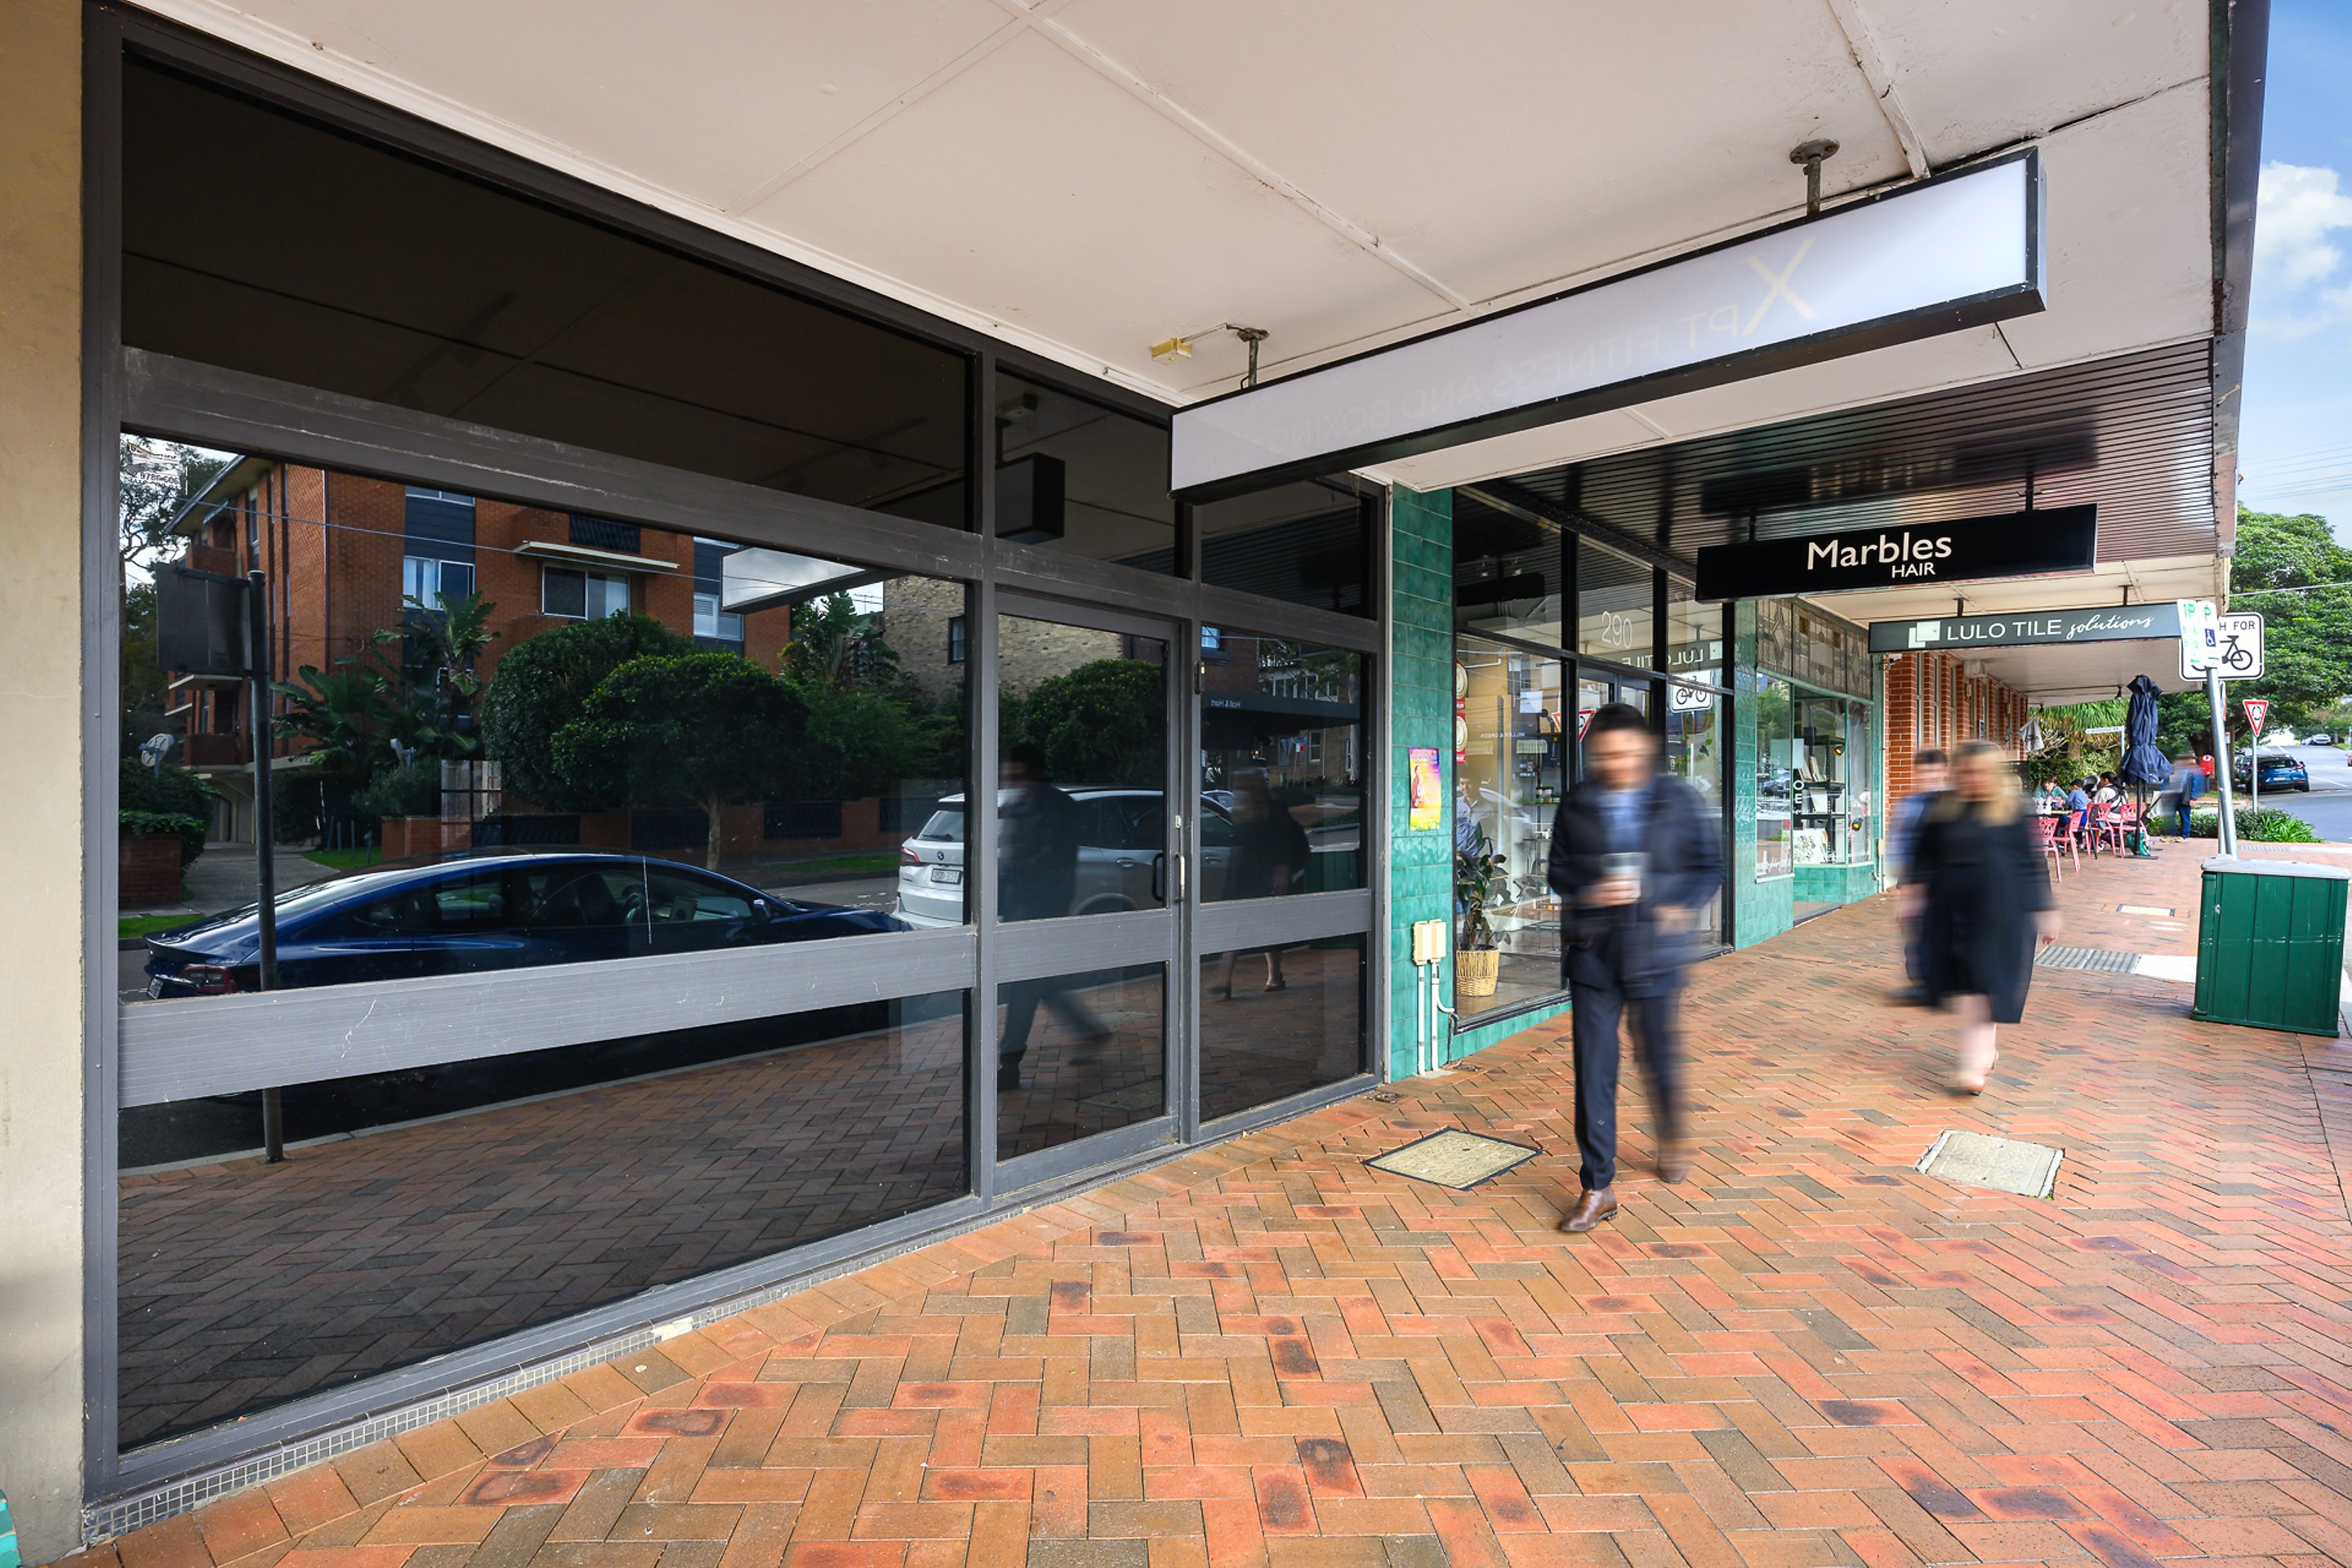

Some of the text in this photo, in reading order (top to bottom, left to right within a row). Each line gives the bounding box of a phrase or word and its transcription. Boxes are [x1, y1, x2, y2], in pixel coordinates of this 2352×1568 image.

[1807, 532, 1952, 570] Marbles
[1891, 562, 1936, 578] HAIR
[1601, 610, 1633, 650] 290
[1947, 614, 2155, 640] LULO TILE solutions
[2234, 621, 2256, 630] FOR
